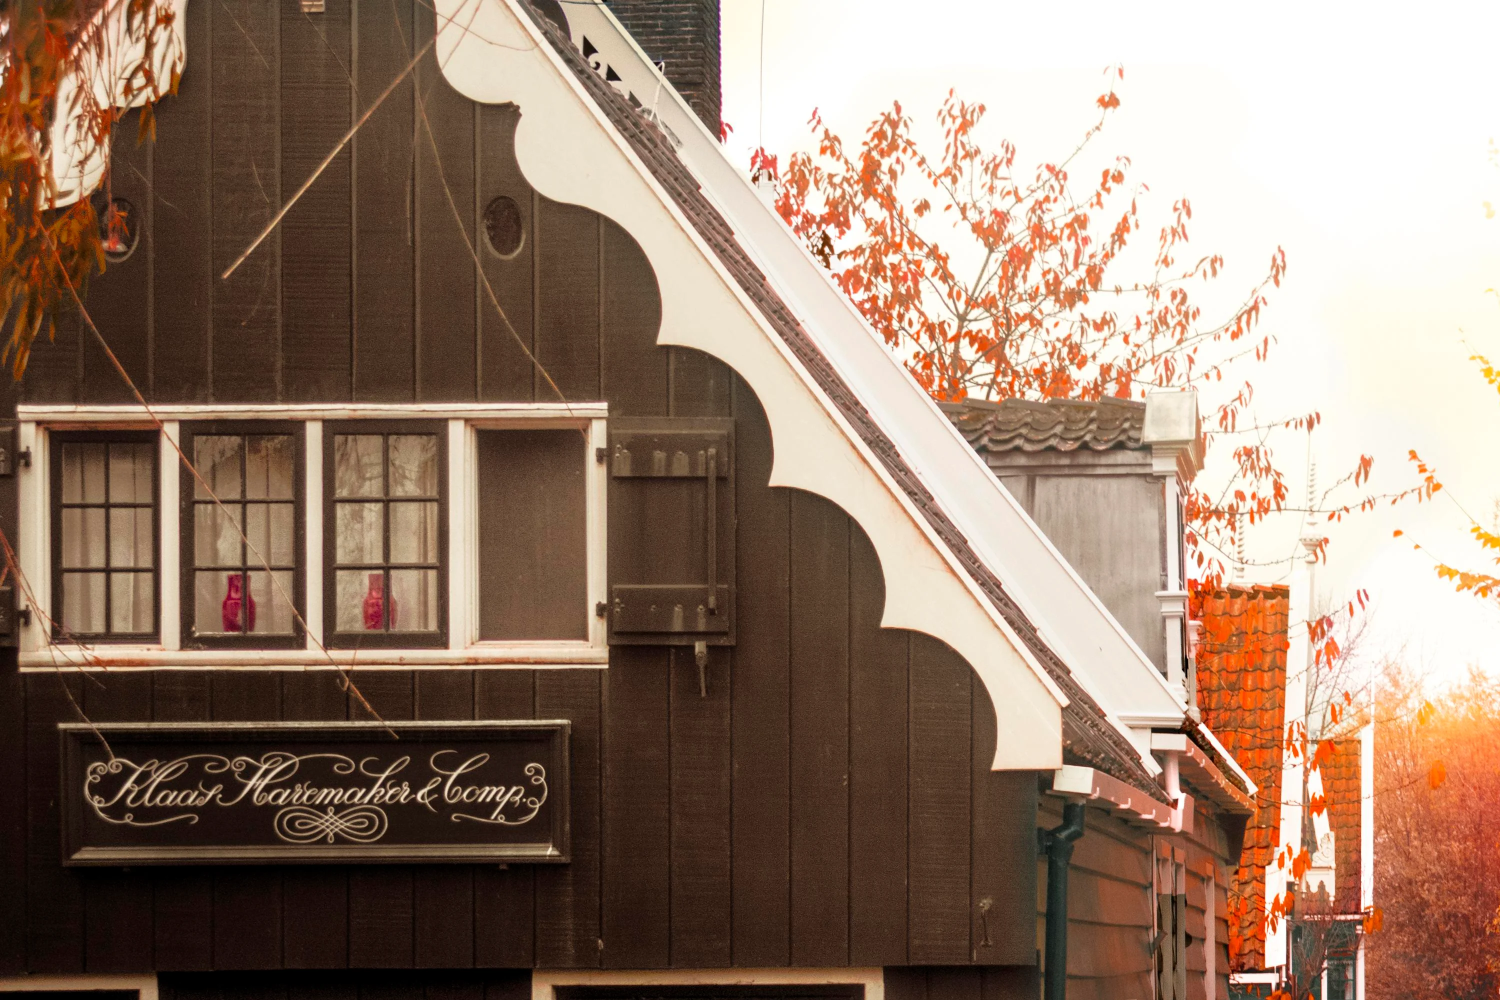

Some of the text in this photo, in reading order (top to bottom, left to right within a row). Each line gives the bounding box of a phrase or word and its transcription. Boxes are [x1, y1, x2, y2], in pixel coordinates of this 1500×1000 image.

[94, 750, 527, 820] Klaas Haremaker & Comp.
